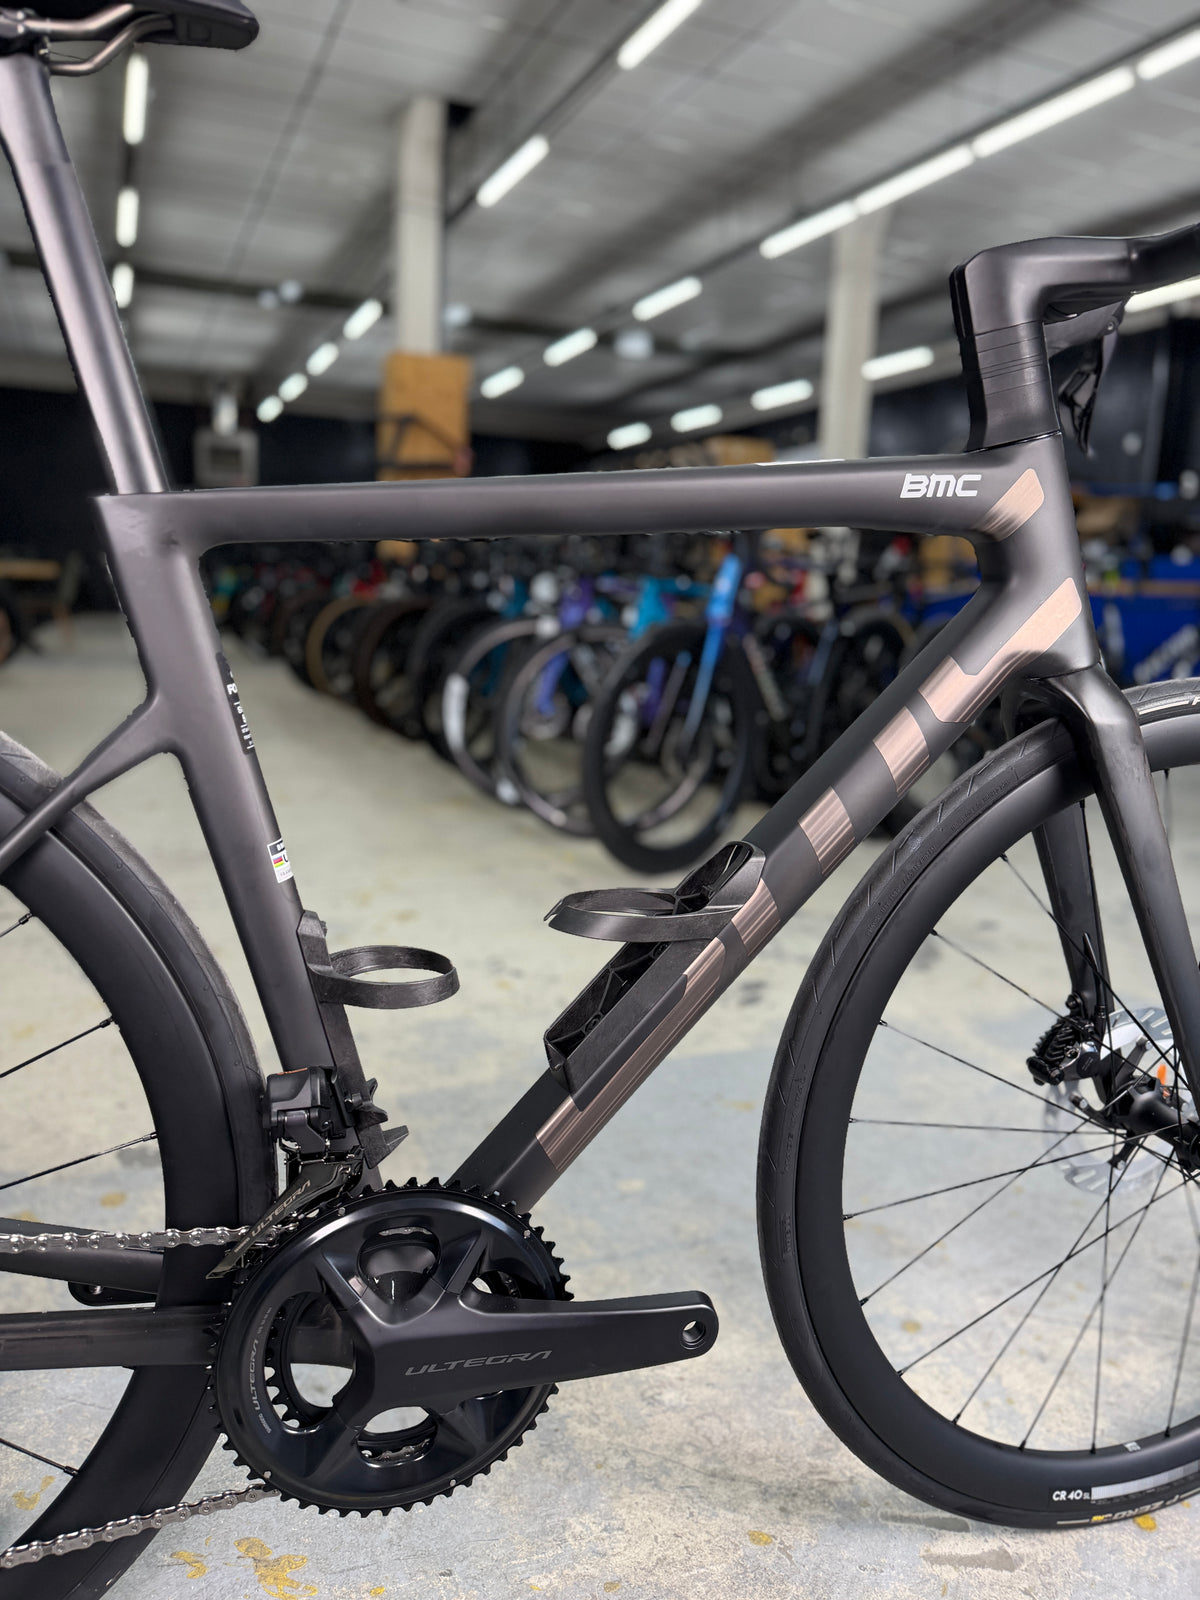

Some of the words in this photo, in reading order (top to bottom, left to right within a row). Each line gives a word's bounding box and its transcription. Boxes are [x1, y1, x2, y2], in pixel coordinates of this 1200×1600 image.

[900, 473, 982, 498] BMC
[251, 1180, 311, 1237] ULTEGRA
[249, 1339, 260, 1411] ULTEGRA
[405, 1350, 552, 1376] ULTEGRA
[1052, 1490, 1067, 1501] CR
[1067, 1489, 1083, 1501] 40
